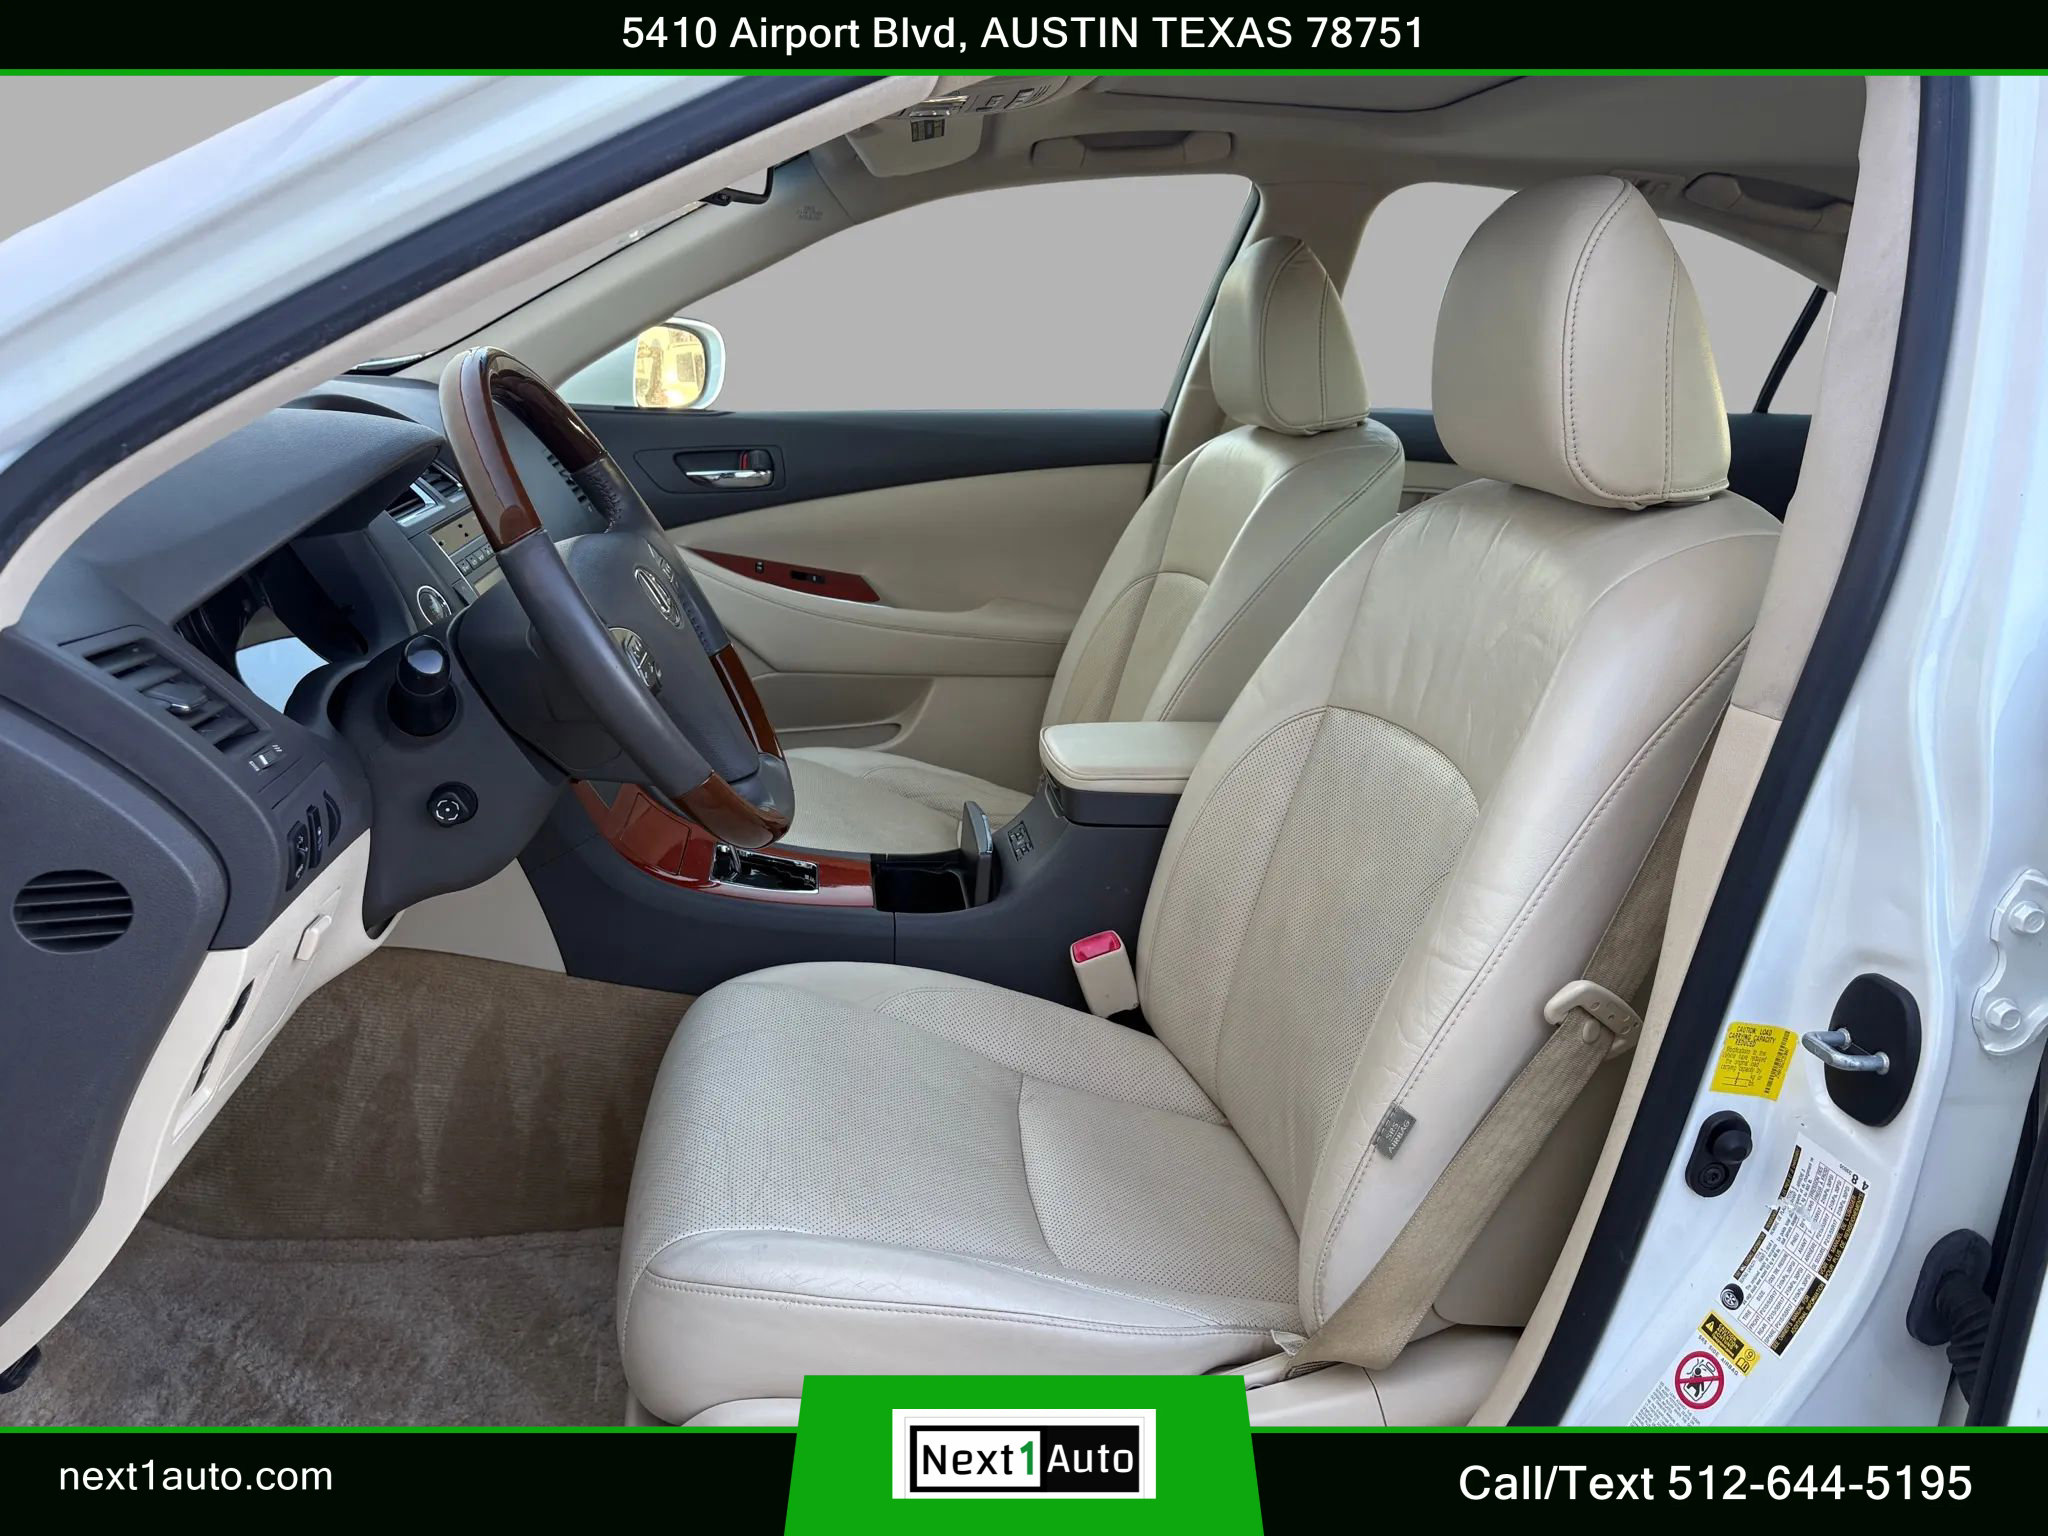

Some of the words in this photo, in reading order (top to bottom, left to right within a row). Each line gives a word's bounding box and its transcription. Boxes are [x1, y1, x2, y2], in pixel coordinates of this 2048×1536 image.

[1742, 1310, 1752, 1321] TIRE
[1708, 1345, 1720, 1356] SIDE
[1720, 1357, 1739, 1375] AIRBAG
